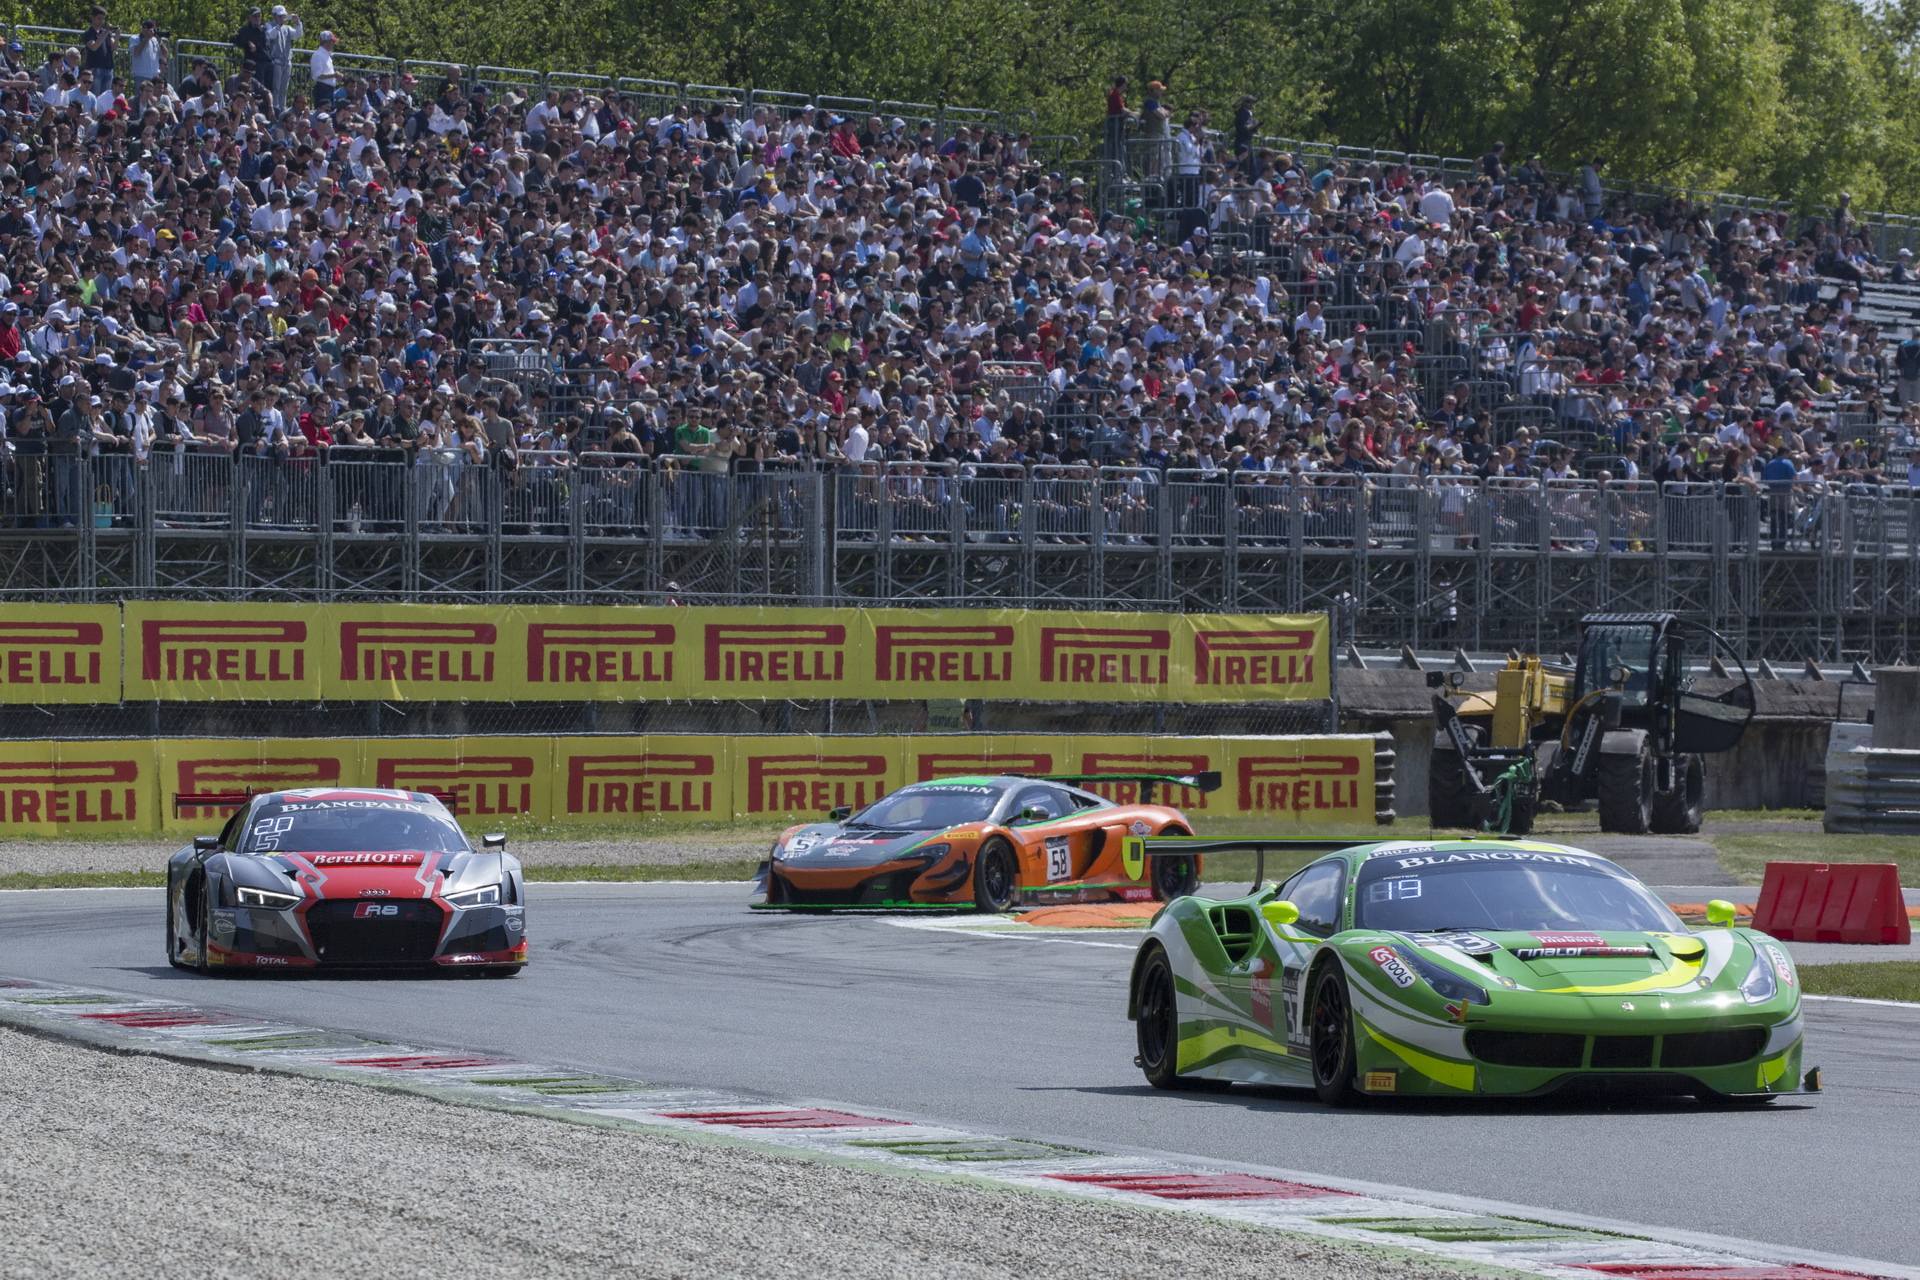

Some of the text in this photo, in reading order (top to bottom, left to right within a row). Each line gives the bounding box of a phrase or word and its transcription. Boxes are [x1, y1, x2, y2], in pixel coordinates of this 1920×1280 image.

[142, 618, 307, 681] PIRELLI
[340, 622, 497, 682] PIRELLI
[528, 624, 676, 682] PIRELLI
[705, 625, 846, 682] PIRELLI
[876, 626, 1014, 681] PIRELLI
[1040, 628, 1170, 684] PIRELLI
[1195, 631, 1314, 684] PIRELLI
[567, 754, 714, 813] PIRELLI
[748, 755, 886, 813] PIRELLI
[901, 785, 993, 795] BLANCPAIN
[1238, 756, 1360, 811] PIRELLI
[254, 816, 294, 836] 20
[281, 801, 422, 813] BLANCPAIN
[313, 853, 414, 865] BergHOFF
[1052, 849, 1067, 877] 58
[1374, 846, 1433, 857] PRO-AM
[1394, 852, 1591, 870] BLANCPAIN
[365, 904, 398, 916] R8
[256, 955, 288, 965] TOTAL
[1370, 947, 1412, 985] KS TOOLS
